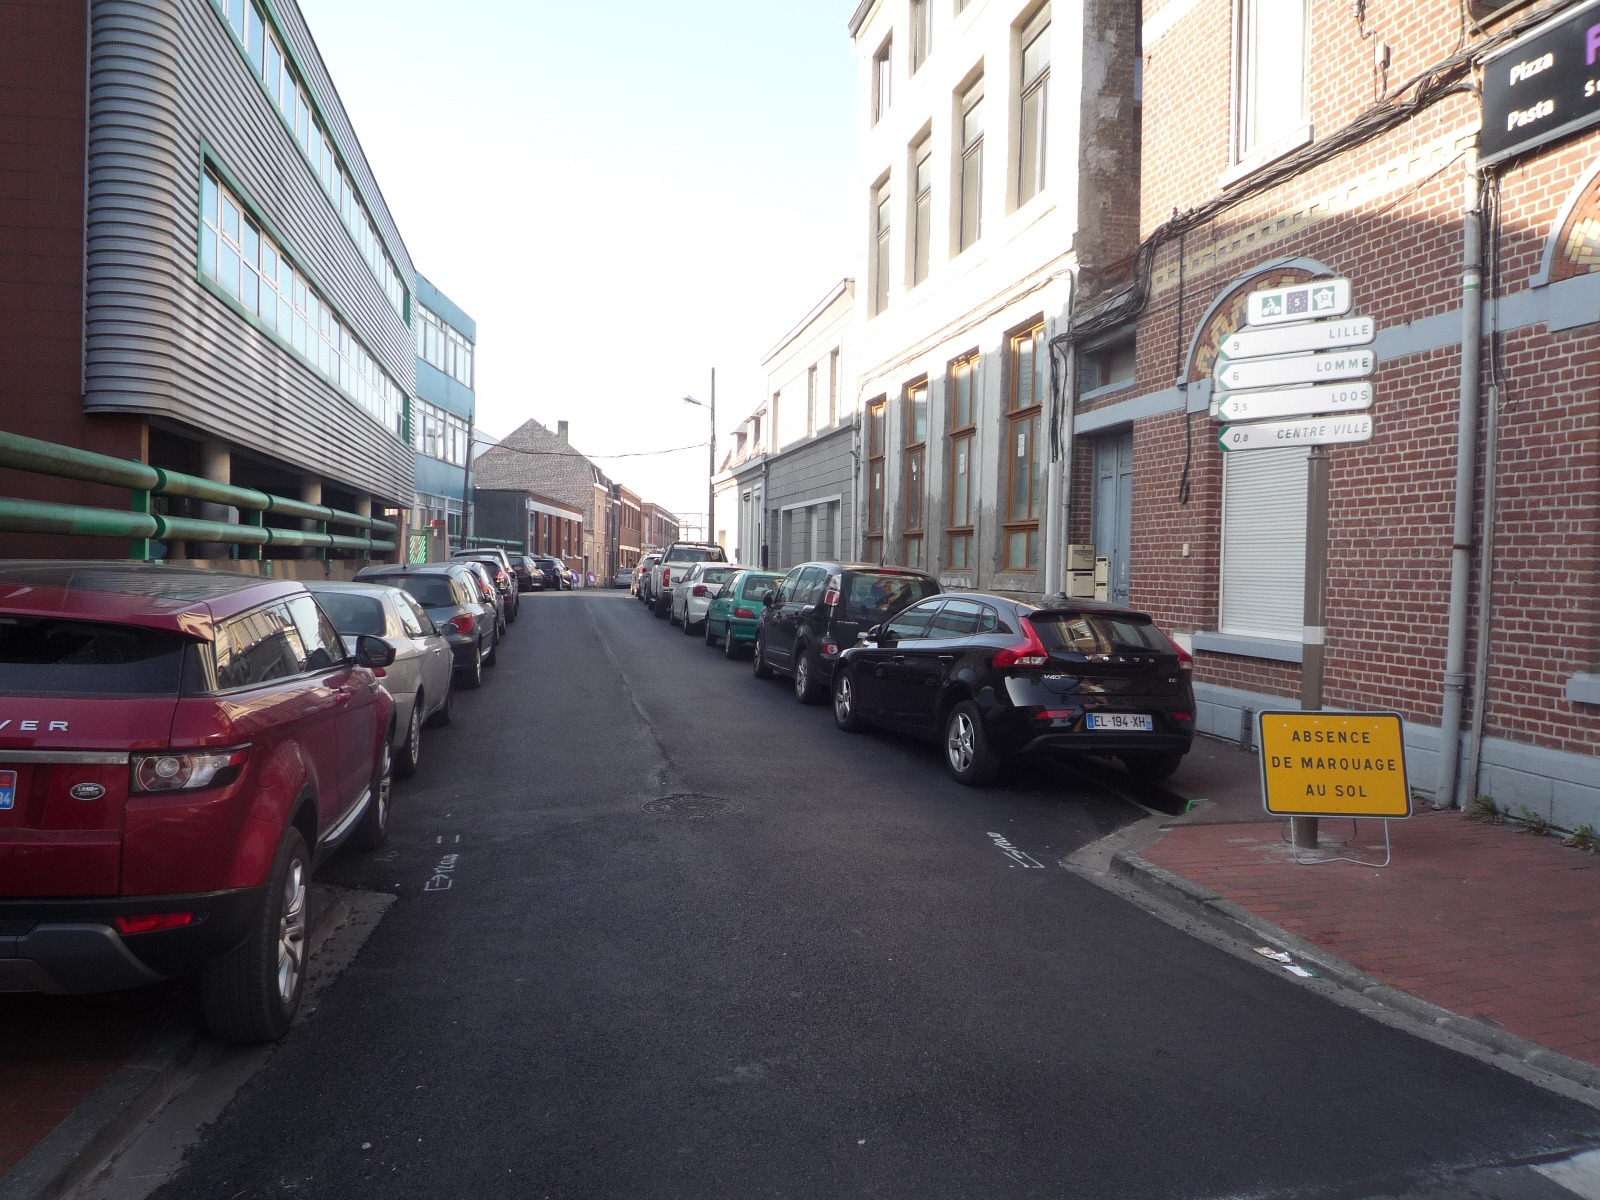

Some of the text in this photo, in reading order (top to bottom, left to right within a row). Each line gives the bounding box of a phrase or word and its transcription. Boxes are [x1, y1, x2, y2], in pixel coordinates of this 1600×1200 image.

[1509, 52, 1554, 86] Pizza
[1507, 99, 1554, 132] Pasta
[1233, 325, 1369, 351] 9 LILLE
[1232, 358, 1369, 381] 6 LOMME
[1331, 391, 1369, 403] LOOS
[1277, 425, 1326, 440] CENTRE
[1333, 422, 1369, 435] VILLE
[1084, 655, 1155, 663] VOLVO
[1093, 715, 1146, 728] EL-194-XH
[1291, 730, 1371, 744] ABSENCE
[1271, 756, 1396, 771] DE MARQUAGE
[1305, 784, 1367, 798] AU SOL
